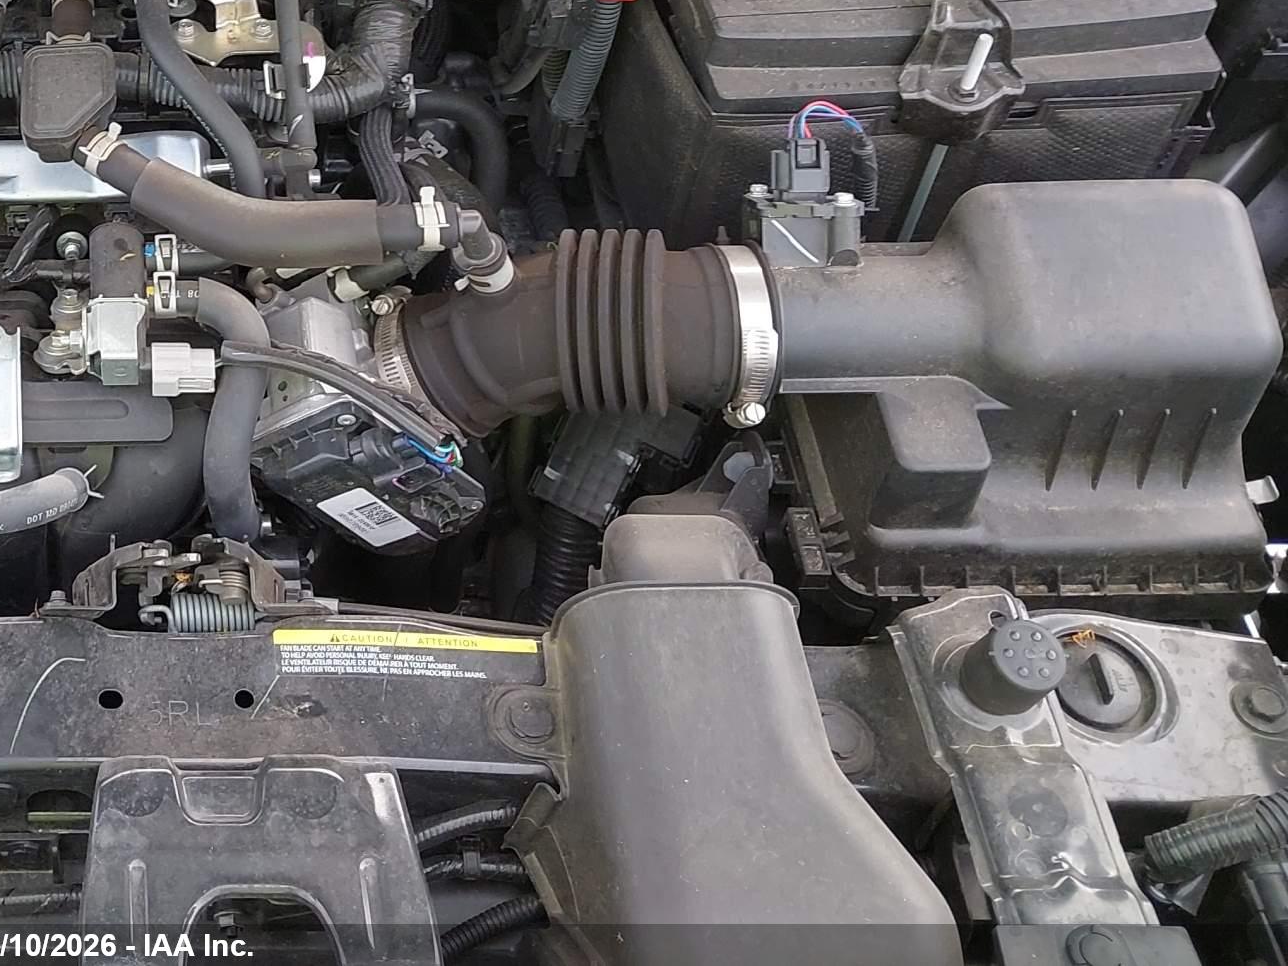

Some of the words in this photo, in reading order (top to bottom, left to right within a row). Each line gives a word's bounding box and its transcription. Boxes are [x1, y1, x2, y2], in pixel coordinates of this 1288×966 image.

[26, 512, 44, 525] DOT
[342, 633, 393, 643] CAUTION
[417, 637, 478, 647] ATTENTION
[293, 644, 311, 652] BLADE
[290, 659, 333, 667] VENTILATEUR
[333, 659, 357, 667] RISQUE
[324, 665, 345, 673] TOUTE
[389, 666, 402, 674] PAS
[414, 669, 452, 677] APPROCHER
